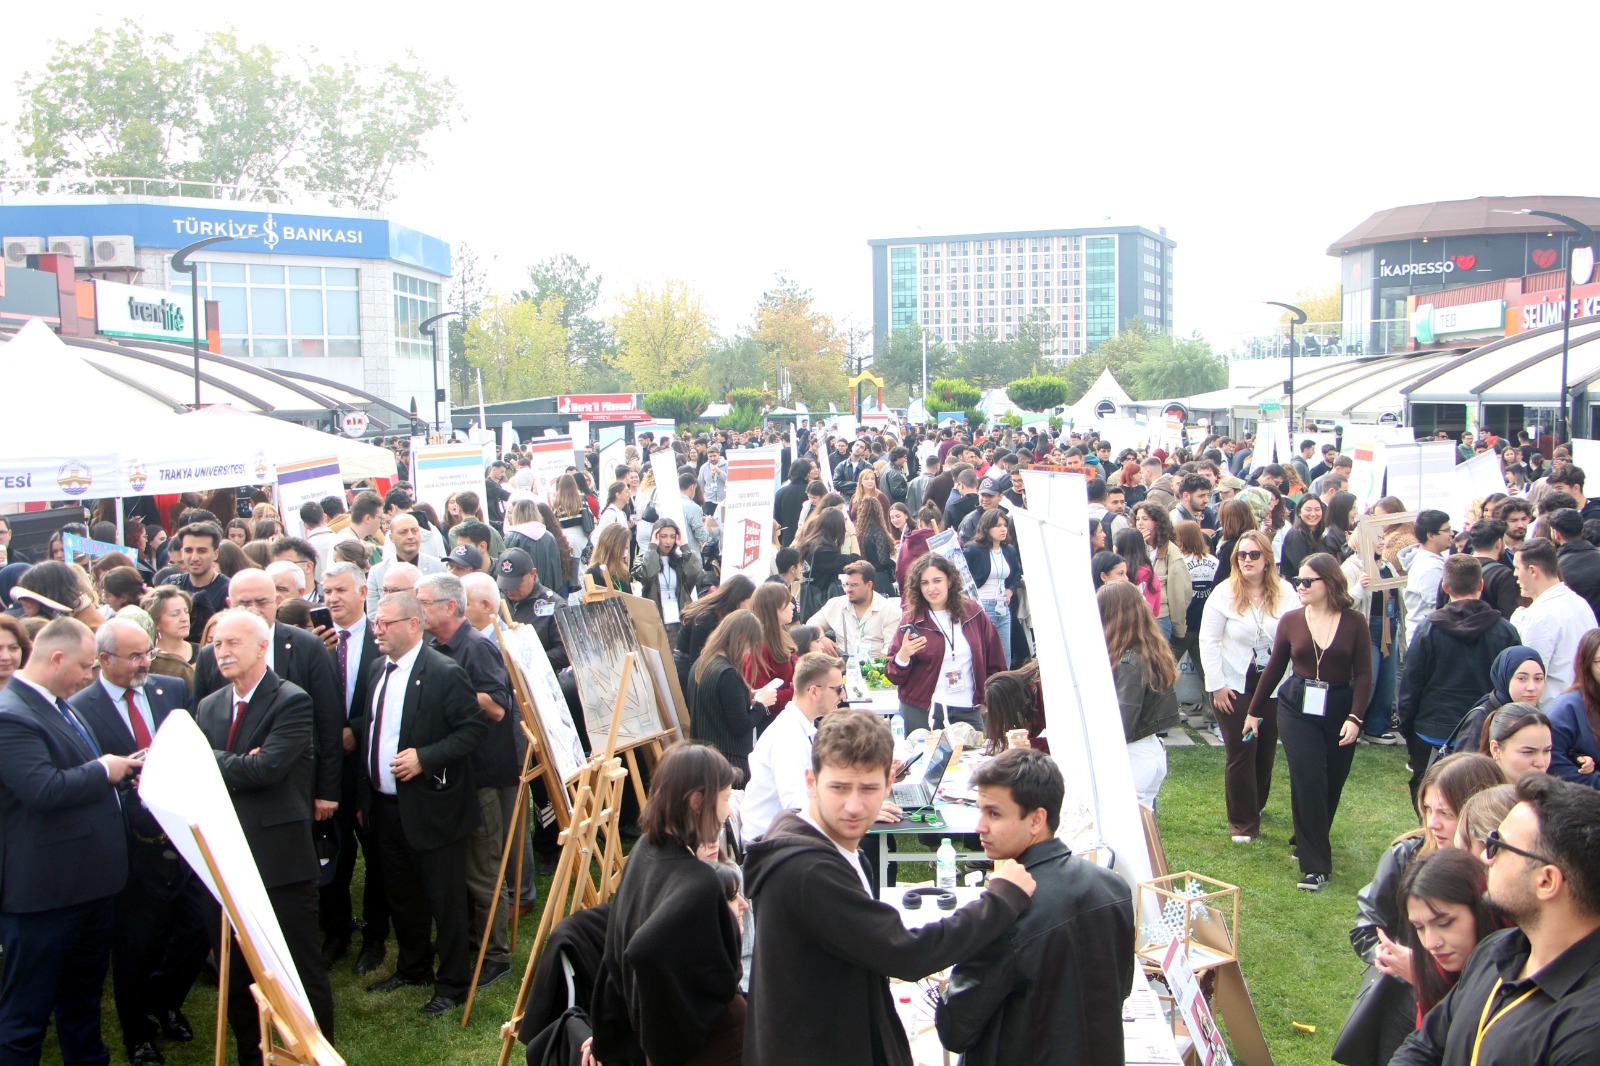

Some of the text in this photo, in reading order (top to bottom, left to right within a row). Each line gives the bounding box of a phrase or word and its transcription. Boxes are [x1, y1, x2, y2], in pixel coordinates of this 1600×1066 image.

[173, 217, 259, 238] TÜRKİYE
[282, 226, 363, 244] BANKASI
[1439, 313, 1457, 329] TEB
[159, 467, 193, 481] TRAKYA
[1187, 558, 1217, 571] OLLEGE
